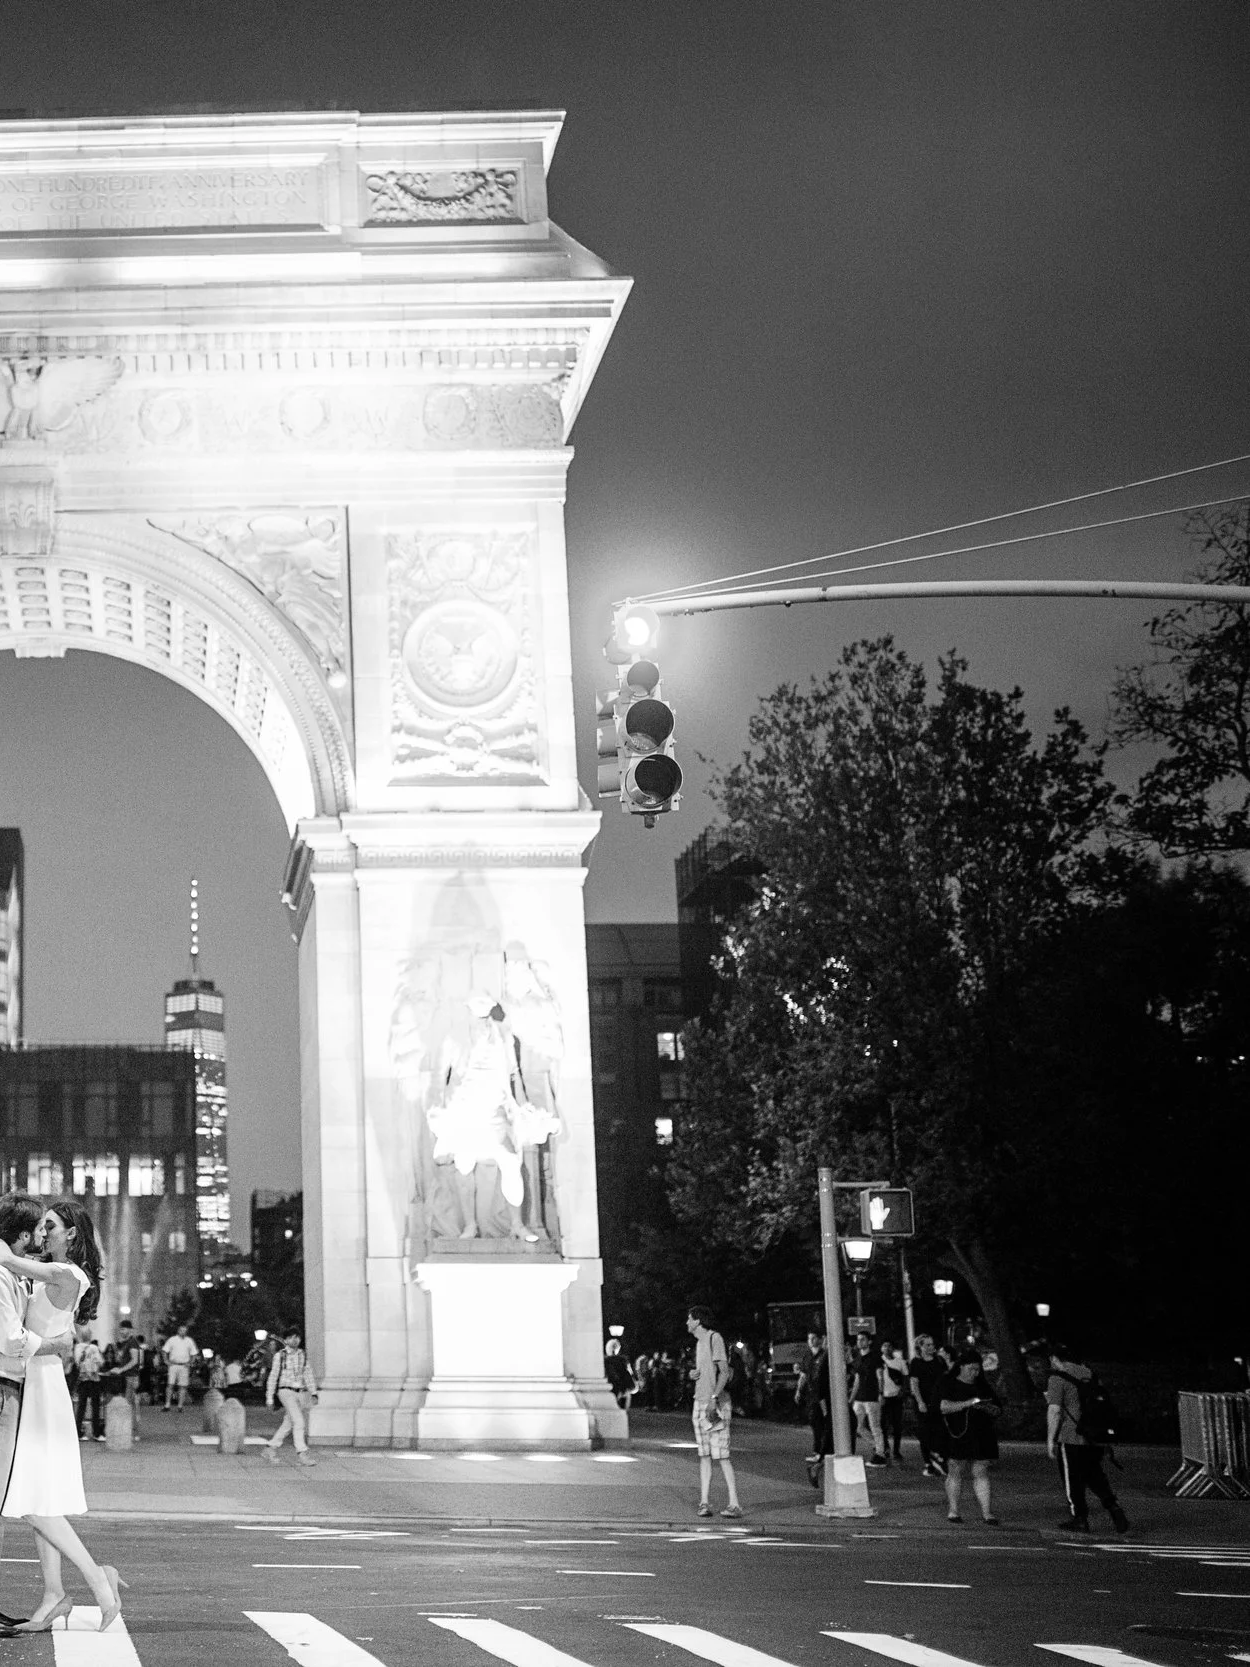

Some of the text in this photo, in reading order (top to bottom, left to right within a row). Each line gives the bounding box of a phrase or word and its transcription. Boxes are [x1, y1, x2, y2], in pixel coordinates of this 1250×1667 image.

[168, 169, 310, 190] ANNIVERSARY
[11, 194, 44, 212] OF
[49, 192, 139, 212] GEORGE
[148, 188, 307, 209] WASHINGTON
[100, 209, 186, 228] UNITED
